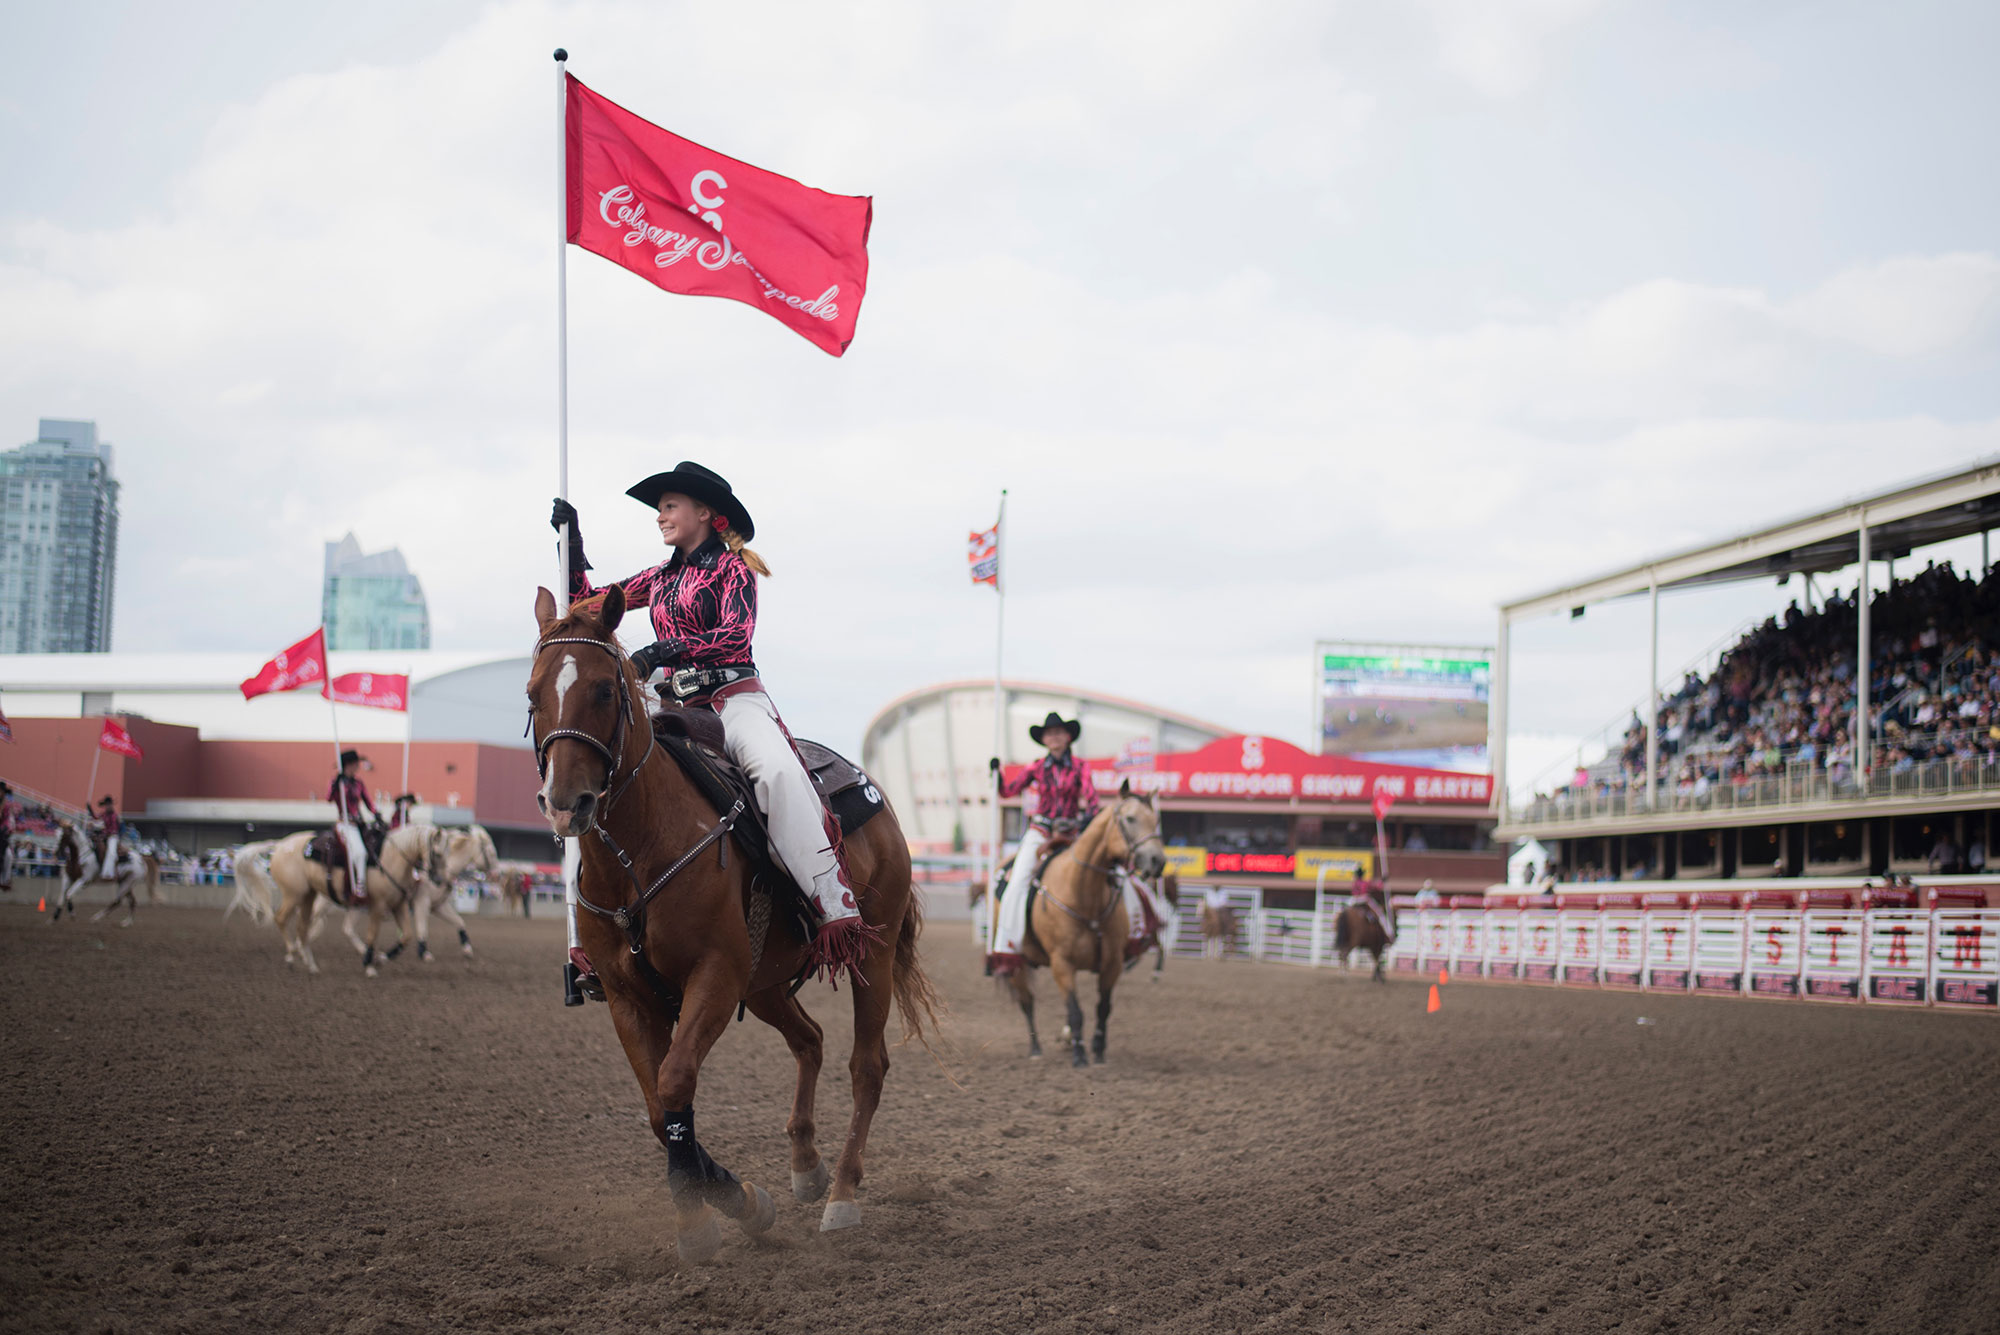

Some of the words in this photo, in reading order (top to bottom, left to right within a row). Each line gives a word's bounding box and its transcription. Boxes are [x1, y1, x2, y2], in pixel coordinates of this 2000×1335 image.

[690, 169, 728, 209] C
[598, 184, 701, 269] Calgary
[696, 234, 840, 322] Spede
[1089, 769, 1182, 793] REATEST
[1189, 772, 1294, 795] OUTDOOR
[1301, 774, 1366, 797] SHOW
[1372, 775, 1406, 798] ON
[1413, 776, 1489, 799] EARTH
[1876, 979, 1917, 998] GMC
[1943, 981, 1988, 1001] GMC
